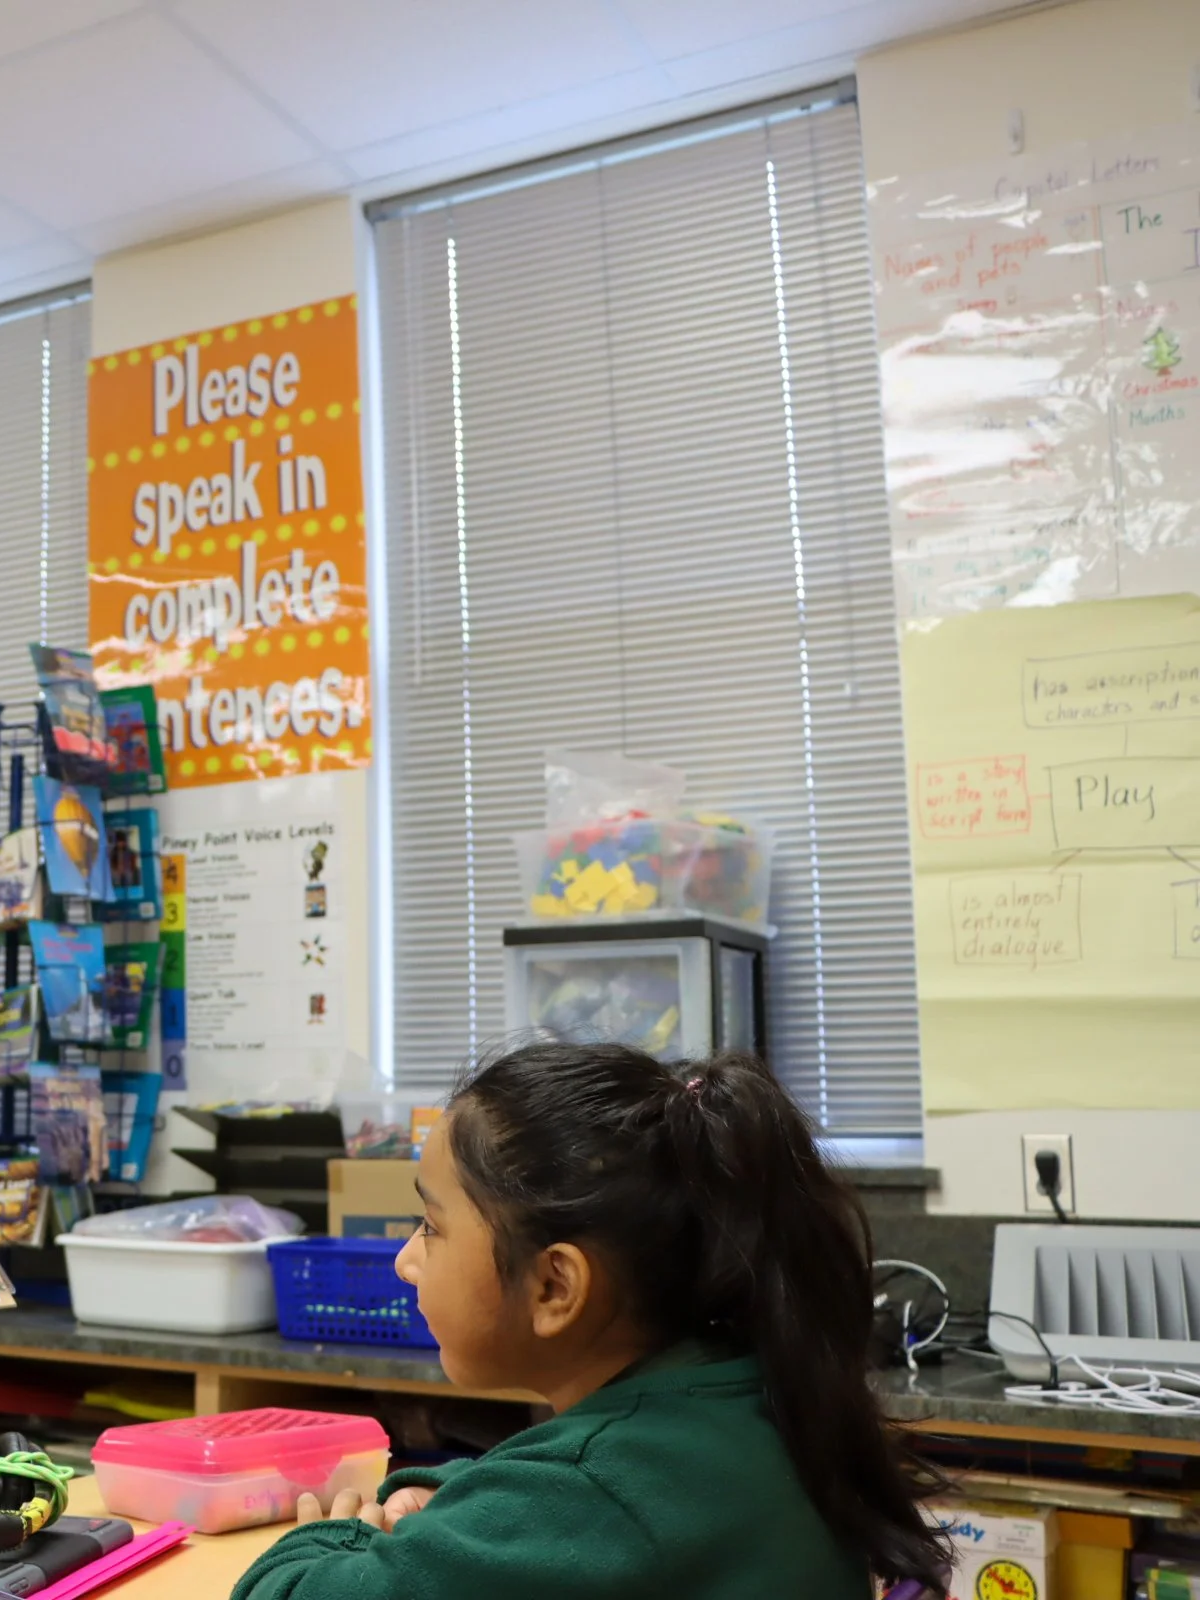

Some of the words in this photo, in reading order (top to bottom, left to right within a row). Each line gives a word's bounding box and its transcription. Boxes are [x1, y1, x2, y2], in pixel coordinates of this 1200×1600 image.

[1091, 154, 1161, 184] Letters
[1117, 205, 1163, 234] The
[955, 231, 976, 263] of
[921, 266, 961, 294] and
[977, 257, 1021, 289] pets
[152, 344, 300, 436] Please
[1123, 375, 1199, 400] Christmas
[1128, 404, 1186, 428] Months
[132, 438, 264, 554] speak
[278, 434, 327, 514] in
[124, 541, 340, 653] complete
[157, 667, 362, 753] ntences.
[1149, 690, 1180, 711] and
[1075, 775, 1156, 821] Play
[162, 835, 198, 850] Piney
[204, 831, 238, 847] Point
[244, 825, 282, 842] Voice
[289, 821, 336, 839] Levels
[994, 879, 1063, 908] almost
[166, 902, 179, 925] 3
[961, 906, 1041, 939] entirely
[962, 932, 1066, 973] dialogue
[166, 1054, 182, 1078] 0
